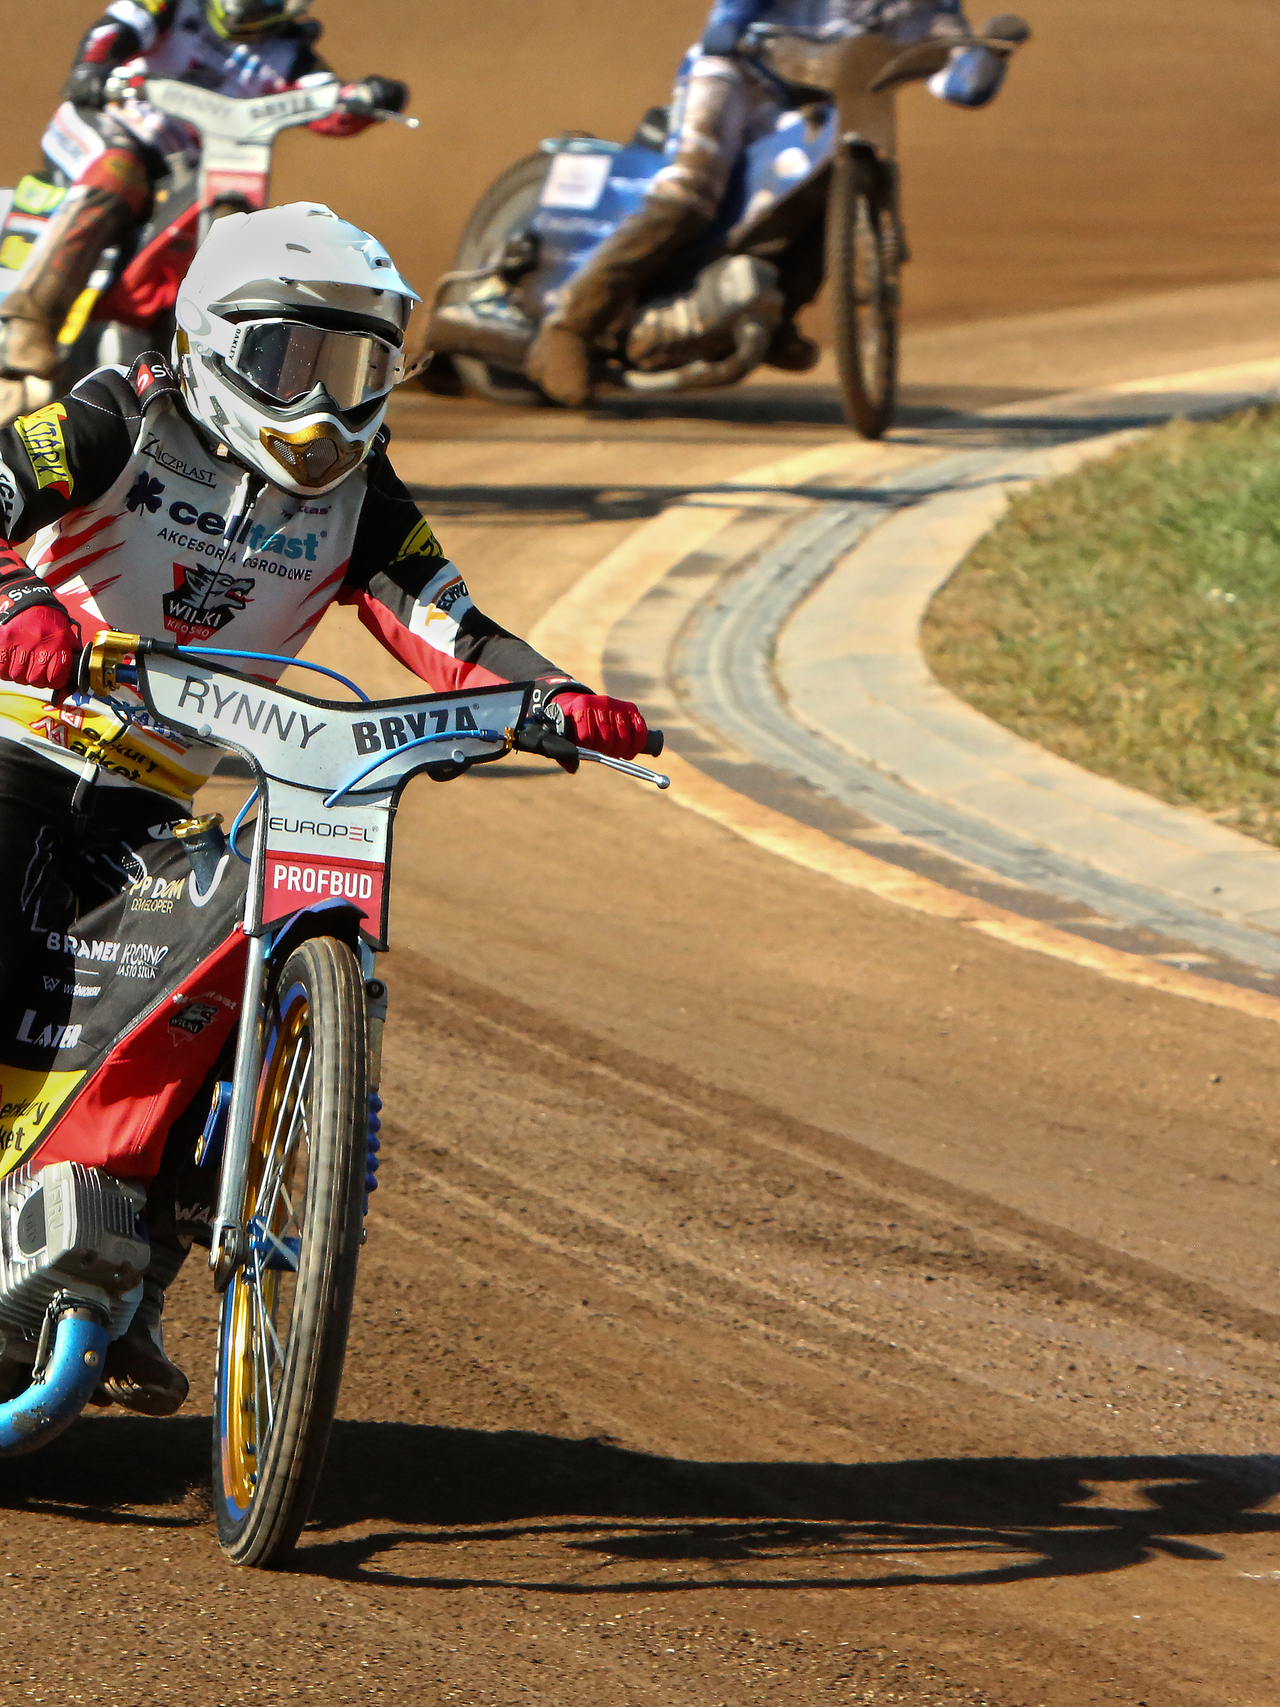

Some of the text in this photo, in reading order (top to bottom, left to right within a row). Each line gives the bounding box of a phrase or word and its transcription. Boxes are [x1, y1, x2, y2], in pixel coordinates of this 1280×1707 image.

[229, 328, 242, 361] OAKLEY
[169, 601, 222, 627] WILKI
[178, 675, 327, 750] RYNNY
[352, 706, 479, 757] BRYZA
[269, 816, 374, 843] EUROPEL
[273, 864, 373, 900] PROFBUD
[46, 932, 121, 963] BRAMEX
[16, 1009, 83, 1049] LATER
